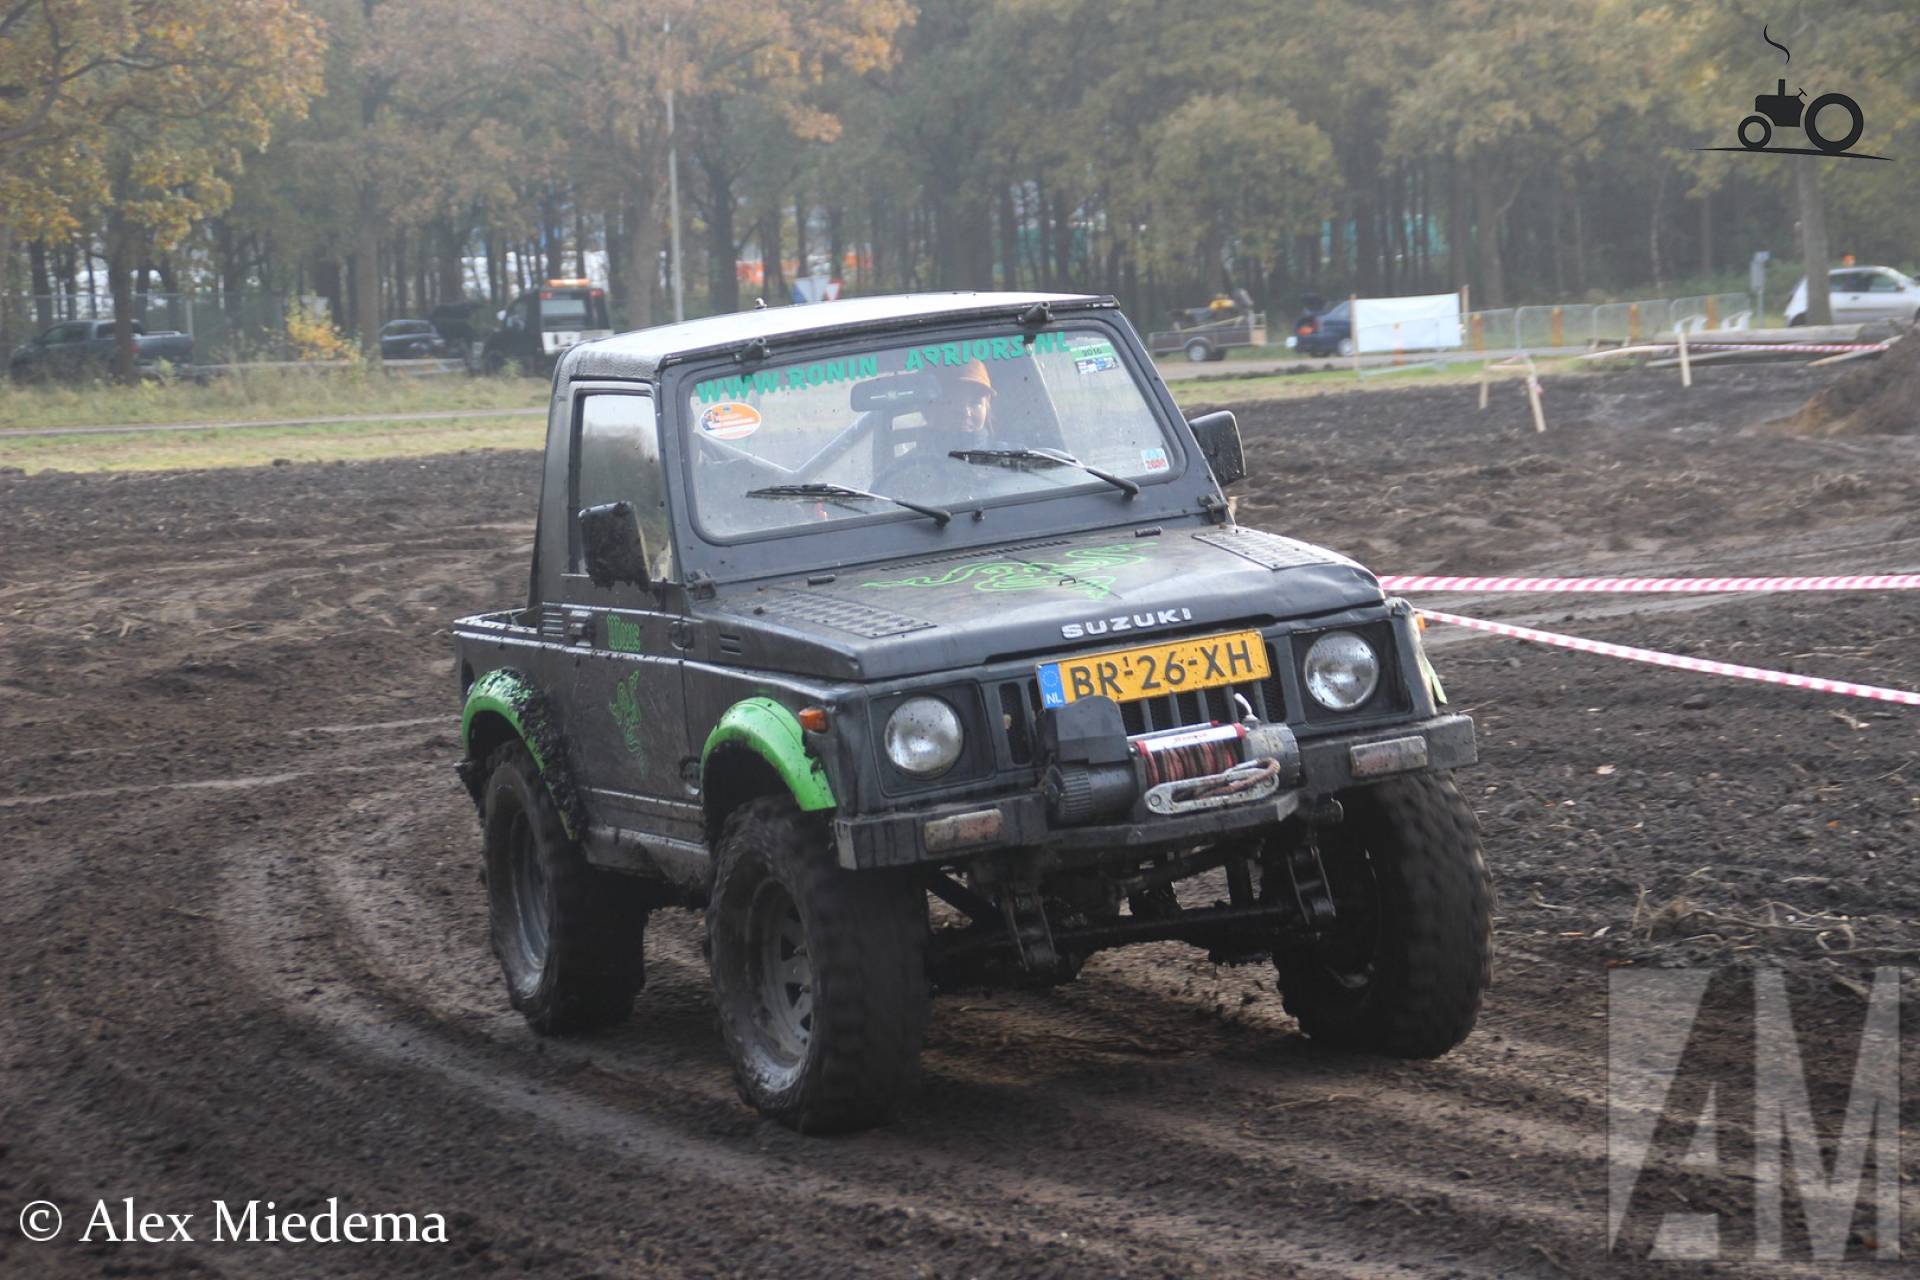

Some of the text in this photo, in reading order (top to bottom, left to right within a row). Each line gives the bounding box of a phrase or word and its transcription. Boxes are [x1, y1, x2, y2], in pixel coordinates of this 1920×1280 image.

[1061, 607, 1193, 639] SUZUKI
[1070, 639, 1252, 700] BR-26-XH
[1045, 692, 1063, 705] NL
